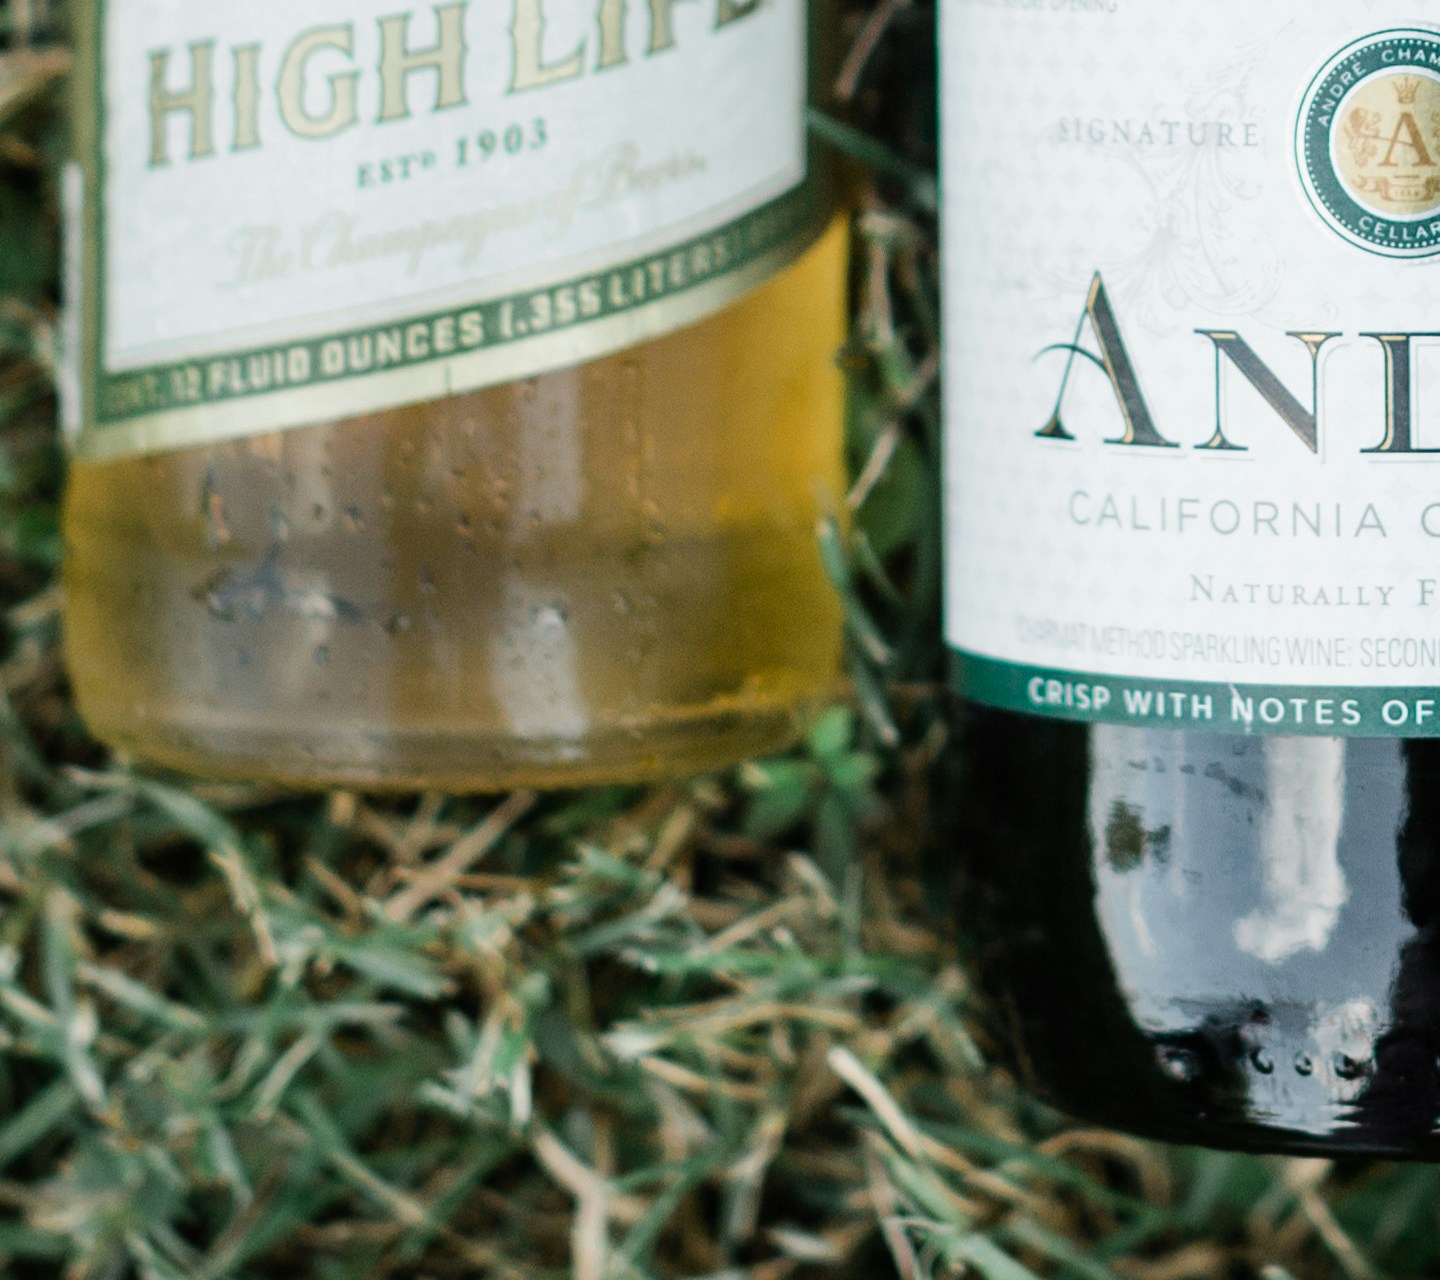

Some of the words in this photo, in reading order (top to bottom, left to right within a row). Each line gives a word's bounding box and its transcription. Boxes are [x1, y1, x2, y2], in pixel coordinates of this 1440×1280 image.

[454, 116, 550, 169] 1903
[1059, 115, 1260, 148] SIGNATURE
[206, 345, 311, 396] FLUID
[320, 310, 484, 376] OUNCES
[1068, 489, 1388, 539] CALIFORNIA
[1188, 574, 1396, 607] NATURALLY
[1170, 632, 1281, 668] SPARKLING
[1284, 636, 1353, 668] WINE:
[1028, 675, 1111, 712] CRISP
[1122, 688, 1214, 721] WITH
[1230, 695, 1361, 726] NOTES
[1381, 699, 1437, 726] OF
